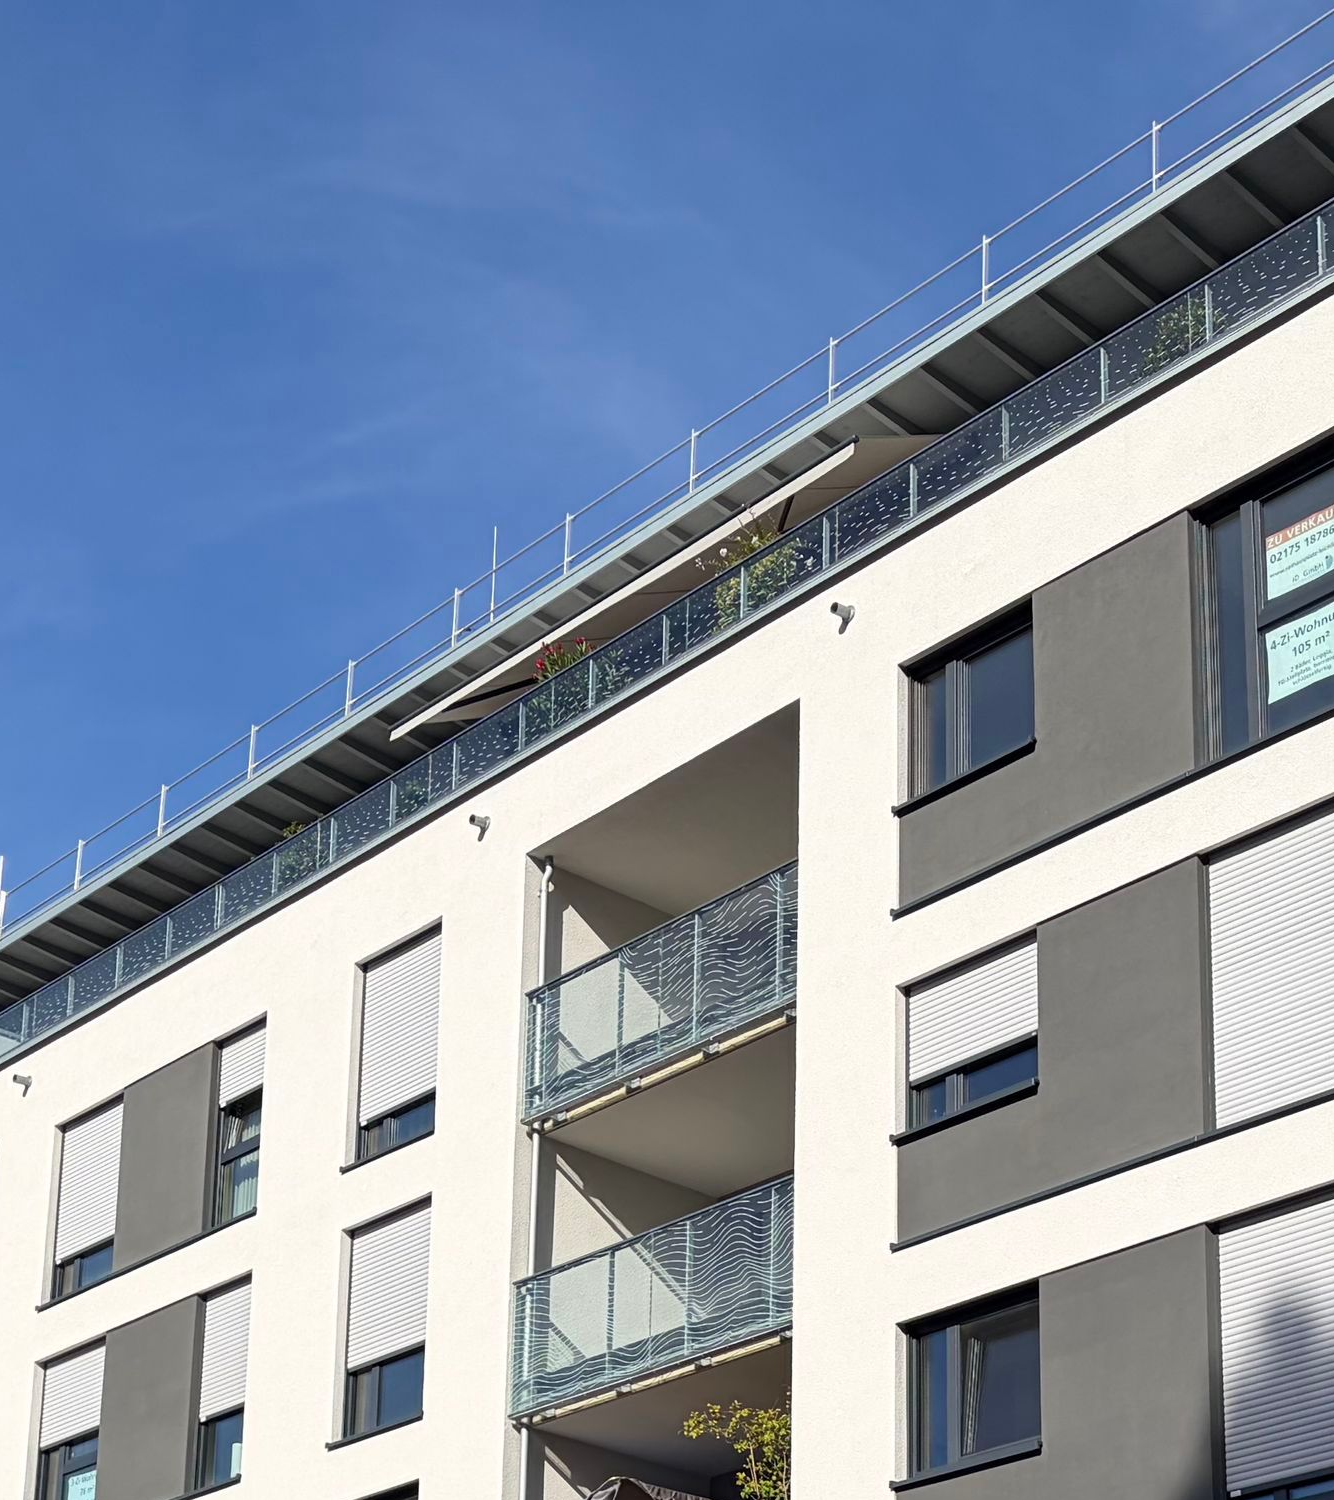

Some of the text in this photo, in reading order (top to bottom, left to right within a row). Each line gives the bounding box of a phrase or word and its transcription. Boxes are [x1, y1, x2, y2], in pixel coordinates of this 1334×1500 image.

[1268, 534, 1283, 548] ZU
[1270, 541, 1301, 564] 02175
[1303, 562, 1324, 577] GmbH
[1292, 640, 1311, 656] 105
